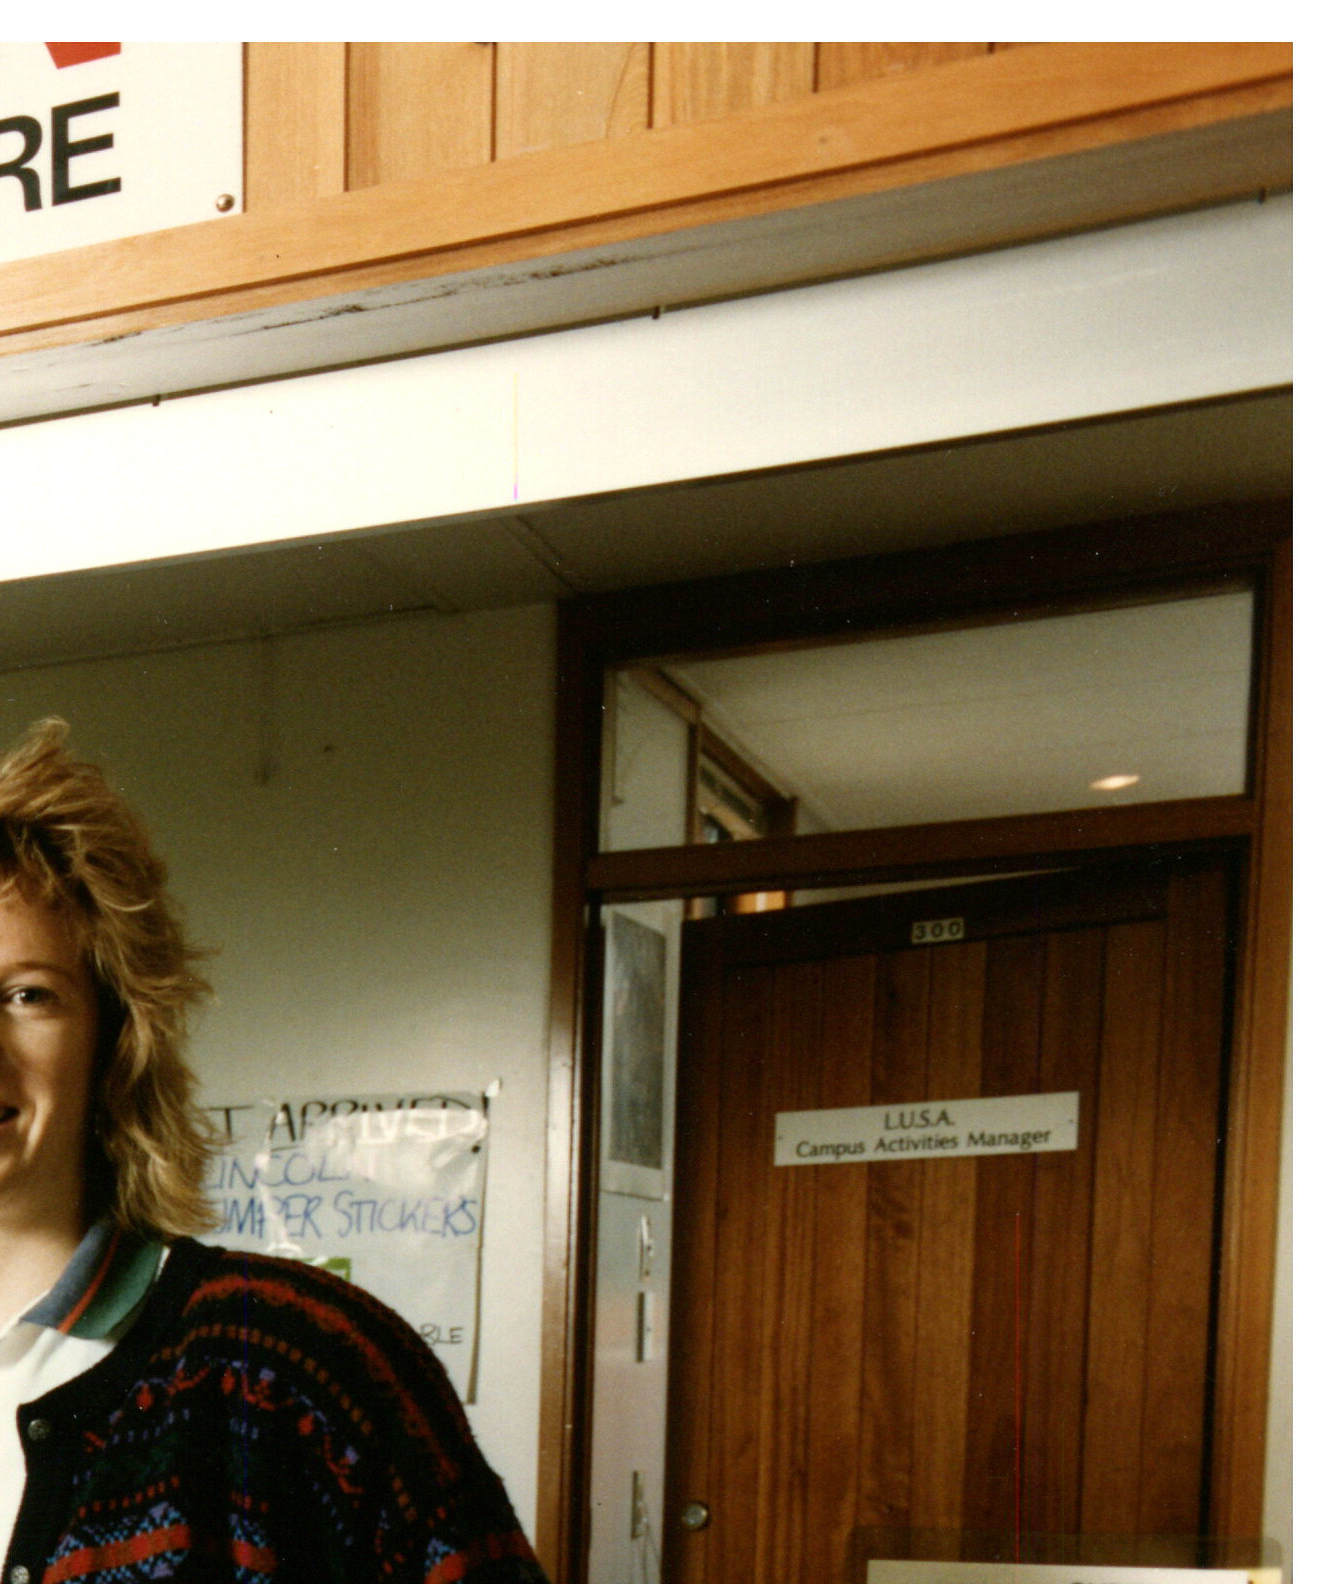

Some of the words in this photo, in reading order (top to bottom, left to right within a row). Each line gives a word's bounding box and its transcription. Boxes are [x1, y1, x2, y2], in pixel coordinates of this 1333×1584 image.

[884, 1109, 956, 1131] L.U.S.A.
[795, 1140, 865, 1160] Campus
[874, 1133, 959, 1154] Activities
[967, 1128, 1052, 1150] Manager
[202, 1153, 373, 1190] LINCOL
[213, 1194, 322, 1240] UMPER
[334, 1190, 477, 1239] STICKERS
